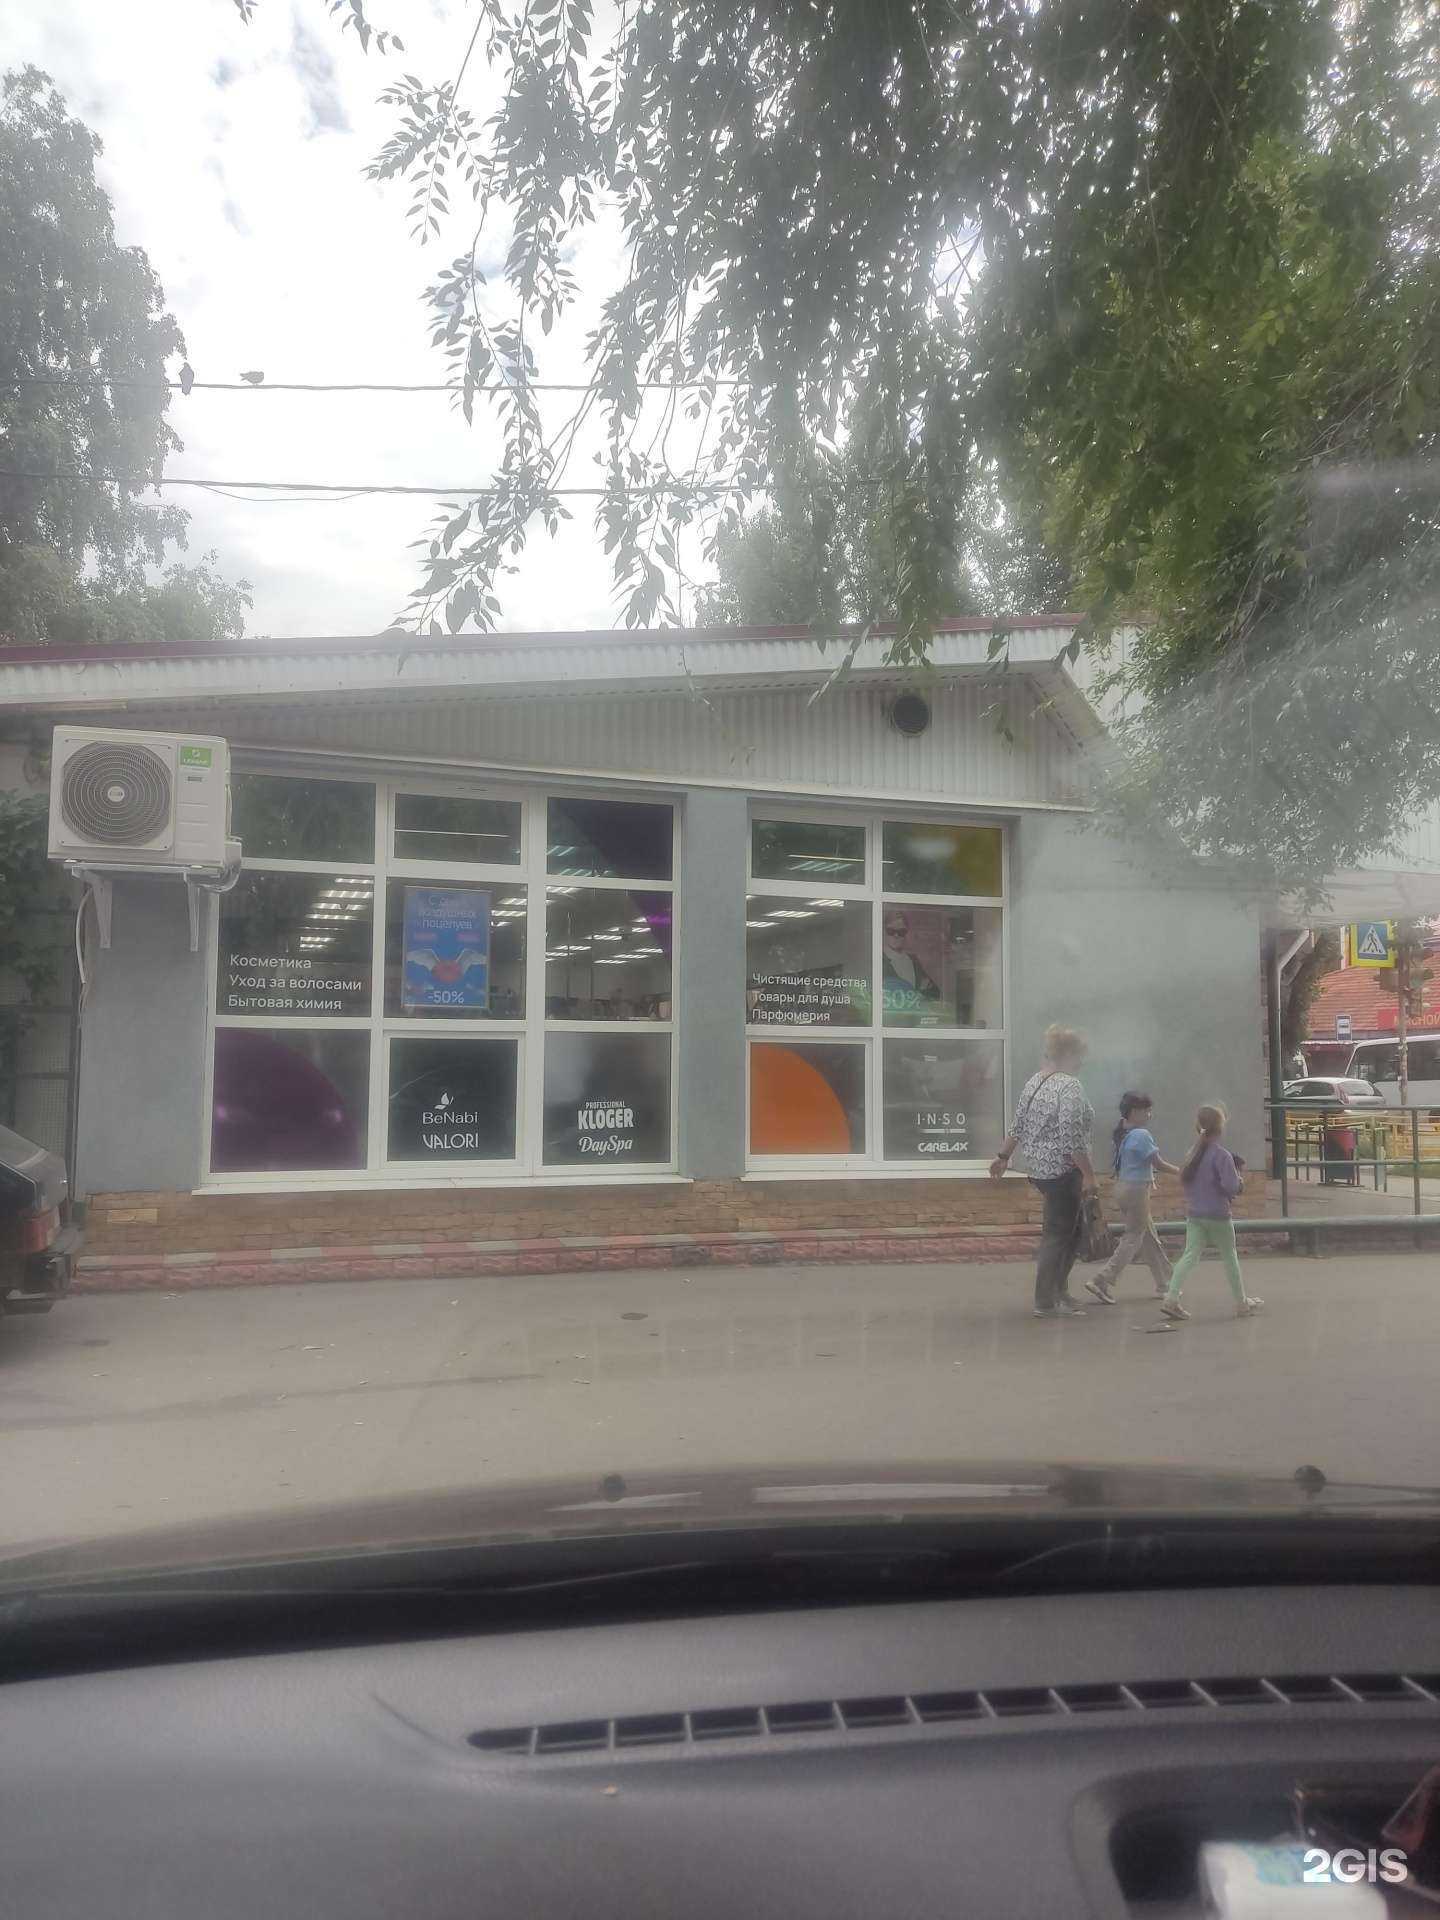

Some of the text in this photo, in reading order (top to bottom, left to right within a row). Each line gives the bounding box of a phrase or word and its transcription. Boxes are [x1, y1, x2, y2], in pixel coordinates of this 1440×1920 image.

[230, 954, 312, 969] Косметика
[229, 974, 362, 991] Уход за волосами
[752, 973, 867, 989] Чистящие средства
[228, 994, 342, 1010] Бытовая химия
[428, 991, 465, 1004] -50%
[797, 995, 819, 1005] для
[821, 995, 850, 1006] душа
[752, 1009, 831, 1022] Парфюмерия
[585, 1100, 626, 1109] PROFESSIONAL
[422, 1111, 478, 1124] BeNabi
[578, 1108, 634, 1130] KLOGER
[422, 1133, 478, 1149] VALORI
[579, 1135, 633, 1156] DaySpa
[918, 1142, 968, 1152] CARELAX
